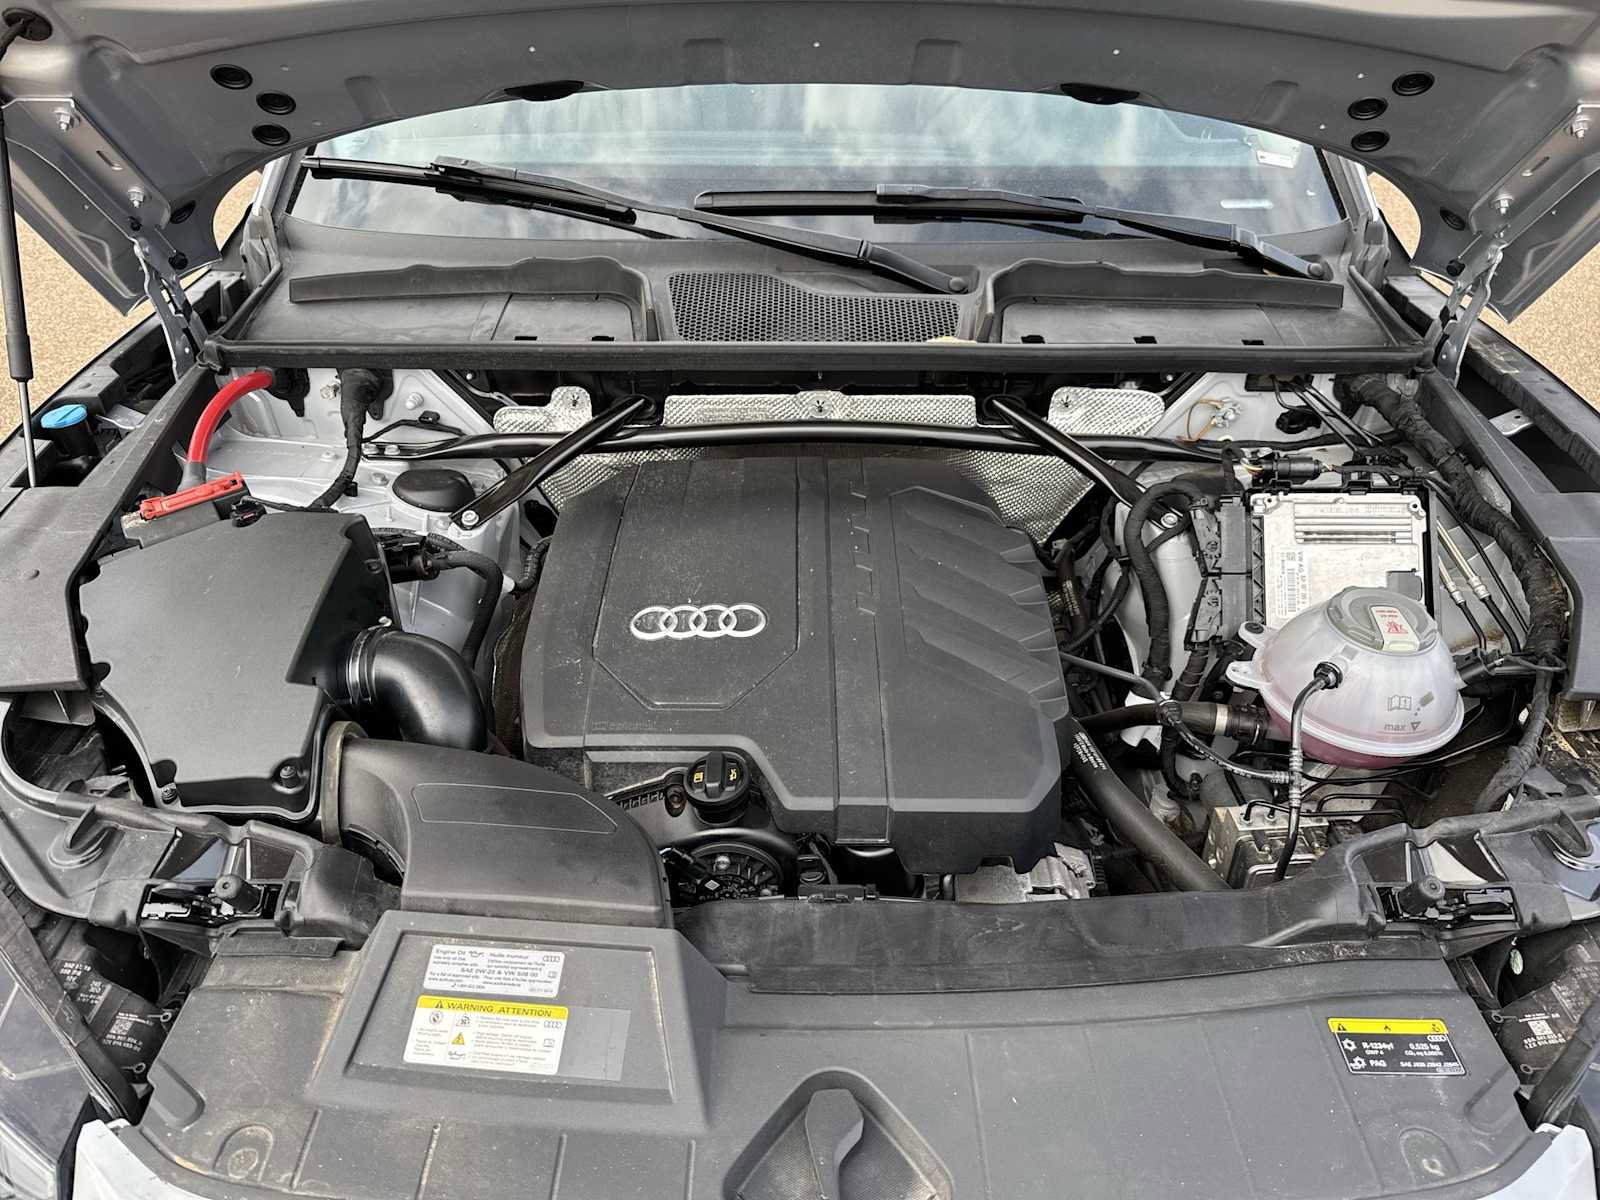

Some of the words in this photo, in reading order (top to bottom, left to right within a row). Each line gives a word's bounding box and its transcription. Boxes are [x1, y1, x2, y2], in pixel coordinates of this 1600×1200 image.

[1384, 723, 1406, 731] max
[447, 1002, 494, 1013] WARNING
[498, 1007, 552, 1017] ATTENTION
